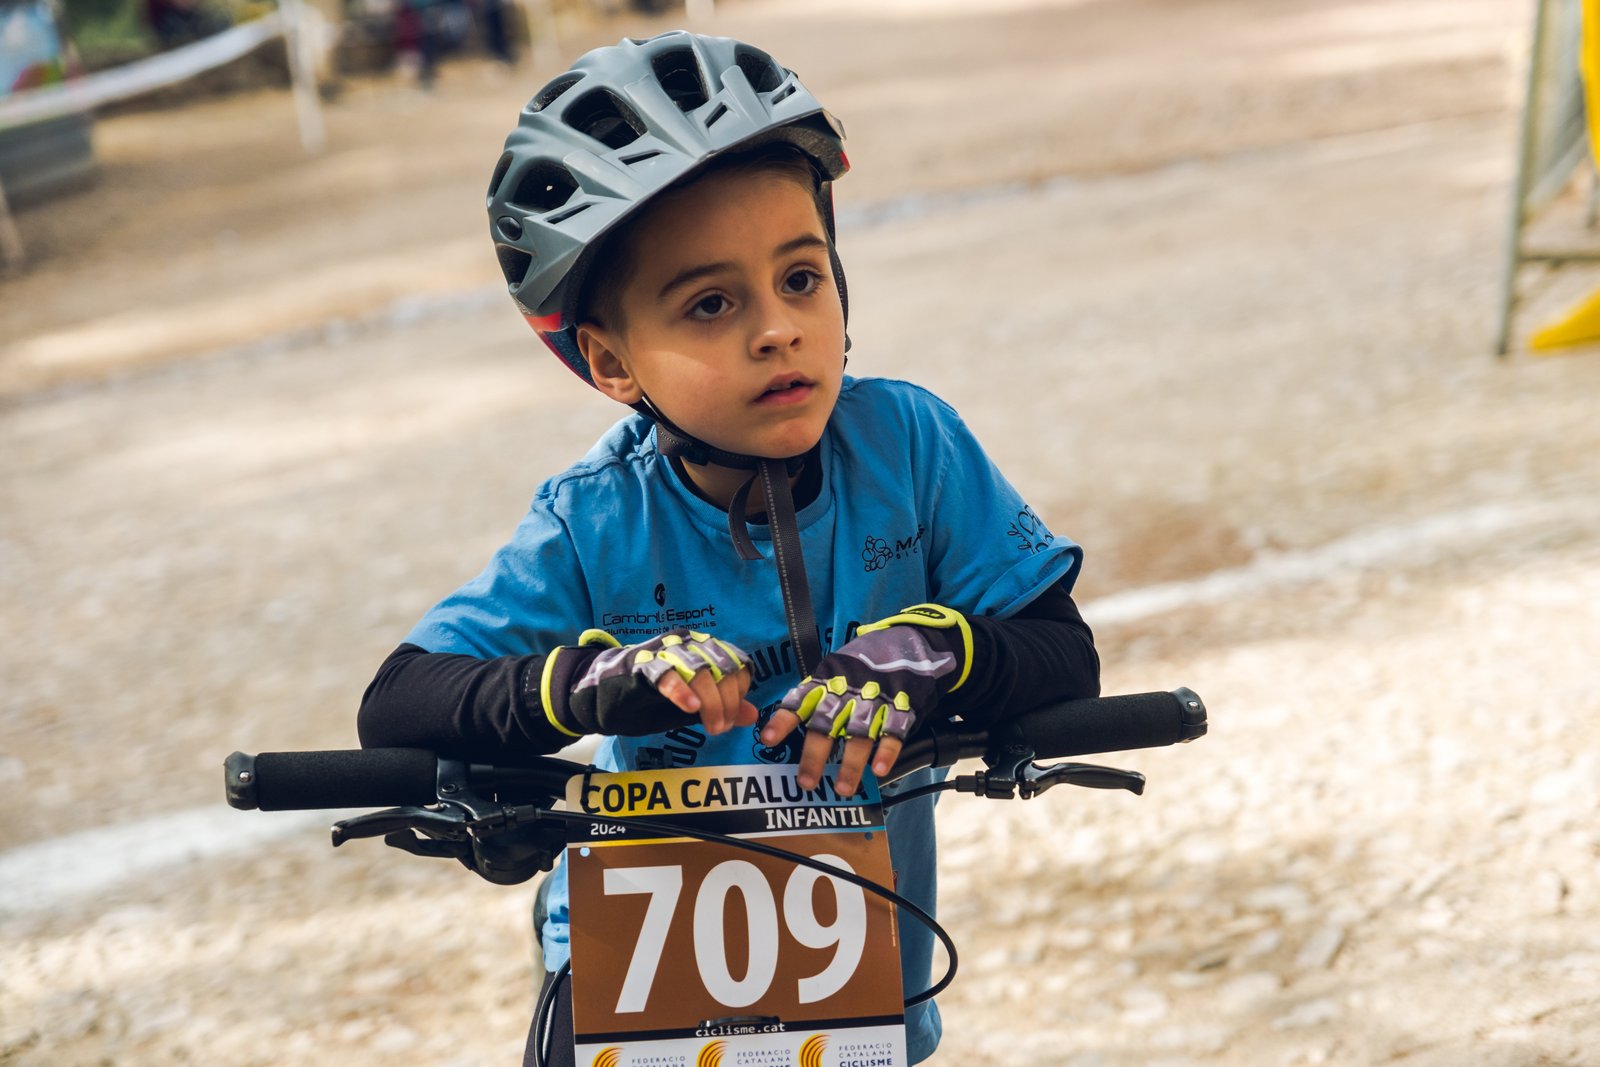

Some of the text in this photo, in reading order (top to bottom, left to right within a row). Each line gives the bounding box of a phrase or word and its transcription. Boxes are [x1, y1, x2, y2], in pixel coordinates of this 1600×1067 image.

[666, 603, 716, 623] Esport
[580, 780, 672, 814] COPA
[765, 807, 871, 829] INFANTIL
[590, 823, 626, 835] 2024
[603, 854, 867, 1014] 709
[695, 1023, 785, 1037] ciclisme.cat
[737, 1056, 790, 1065] CATALANA
[839, 1050, 892, 1059] CATALANA
[839, 1058, 893, 1067] CICLISME
